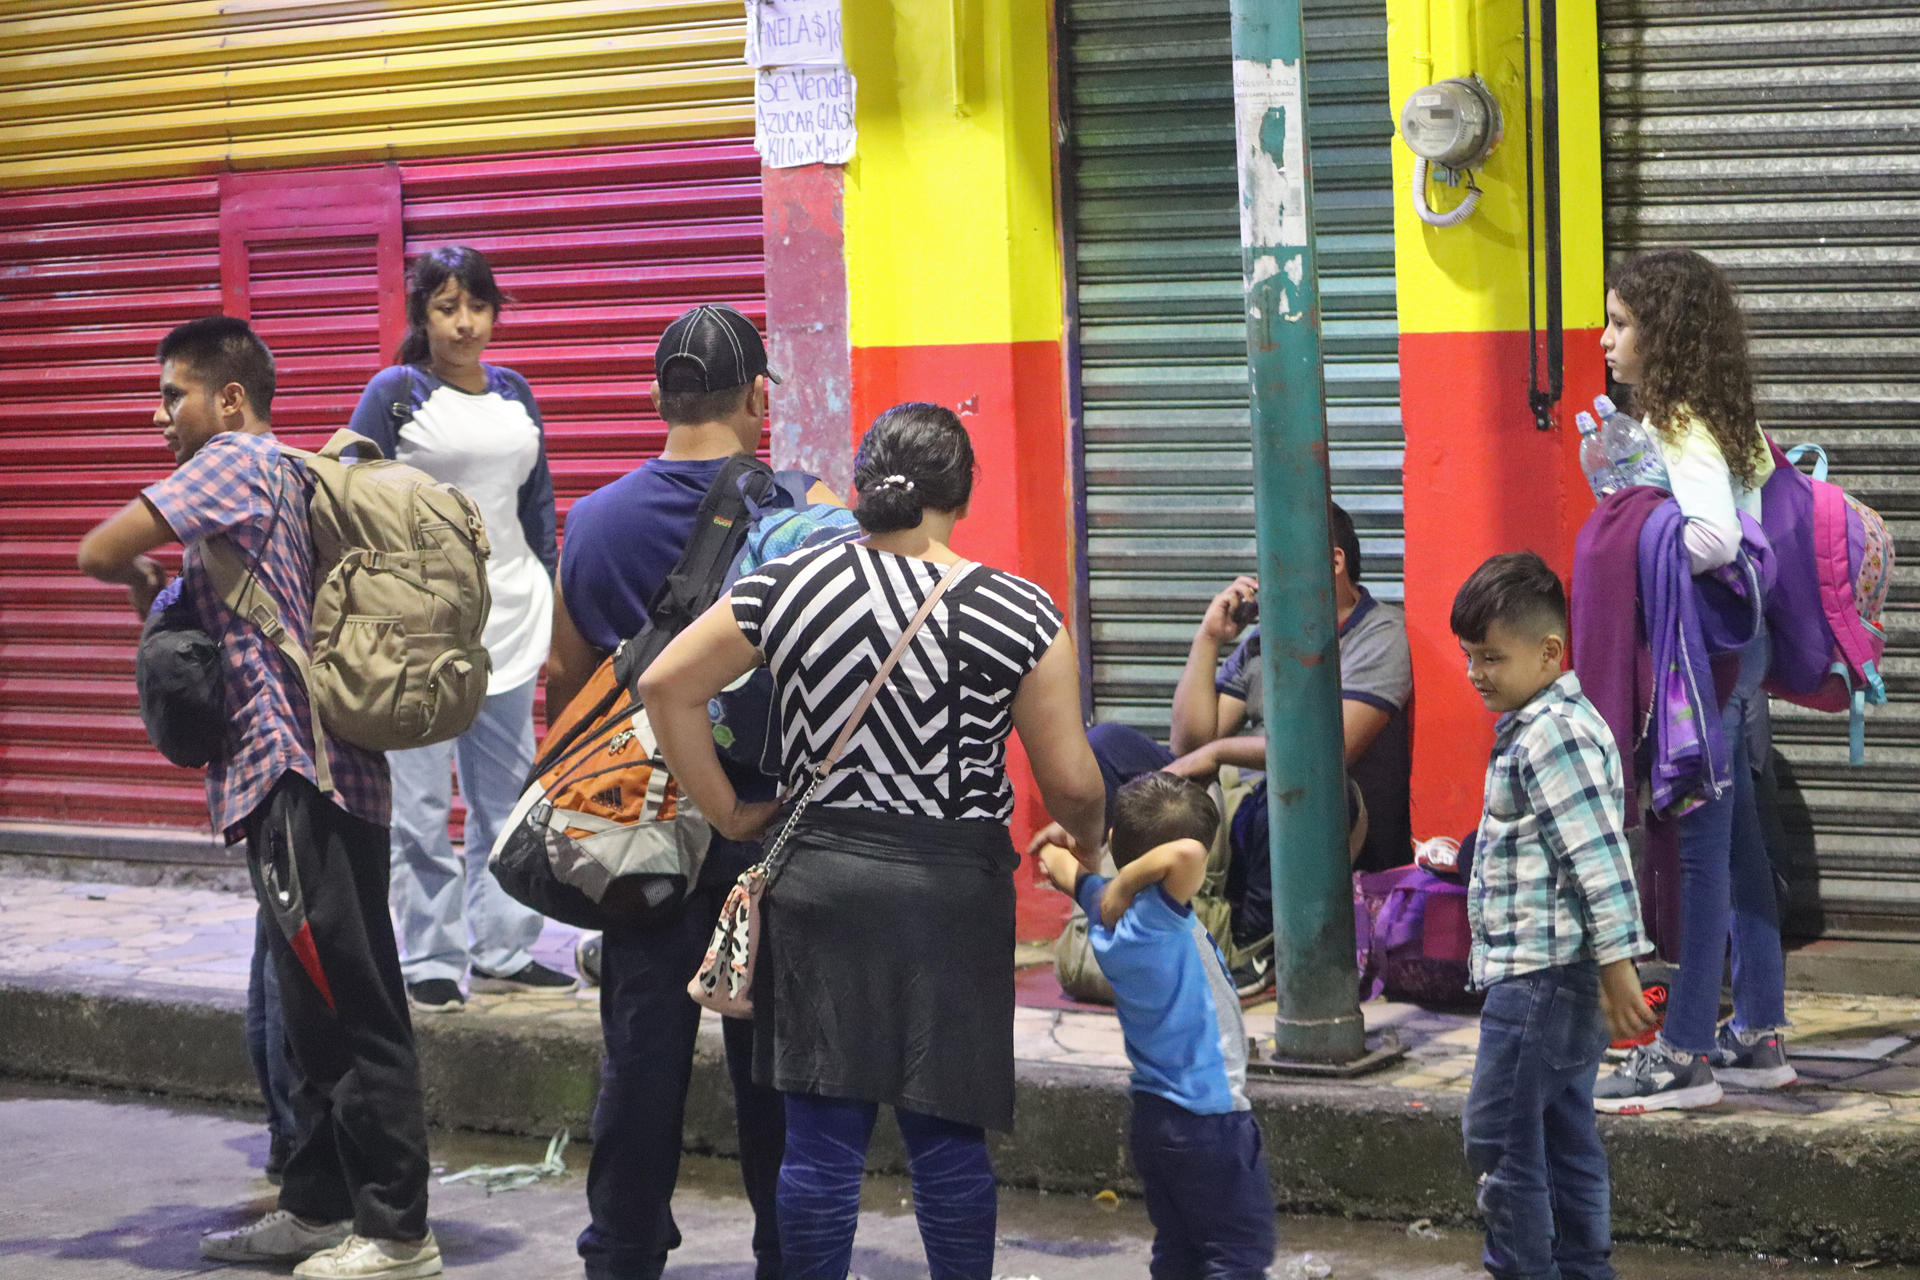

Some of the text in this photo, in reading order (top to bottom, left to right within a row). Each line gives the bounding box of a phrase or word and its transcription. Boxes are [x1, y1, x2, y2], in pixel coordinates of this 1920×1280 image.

[758, 67, 851, 103] Se Vende
[758, 104, 815, 136] AZUCAR
